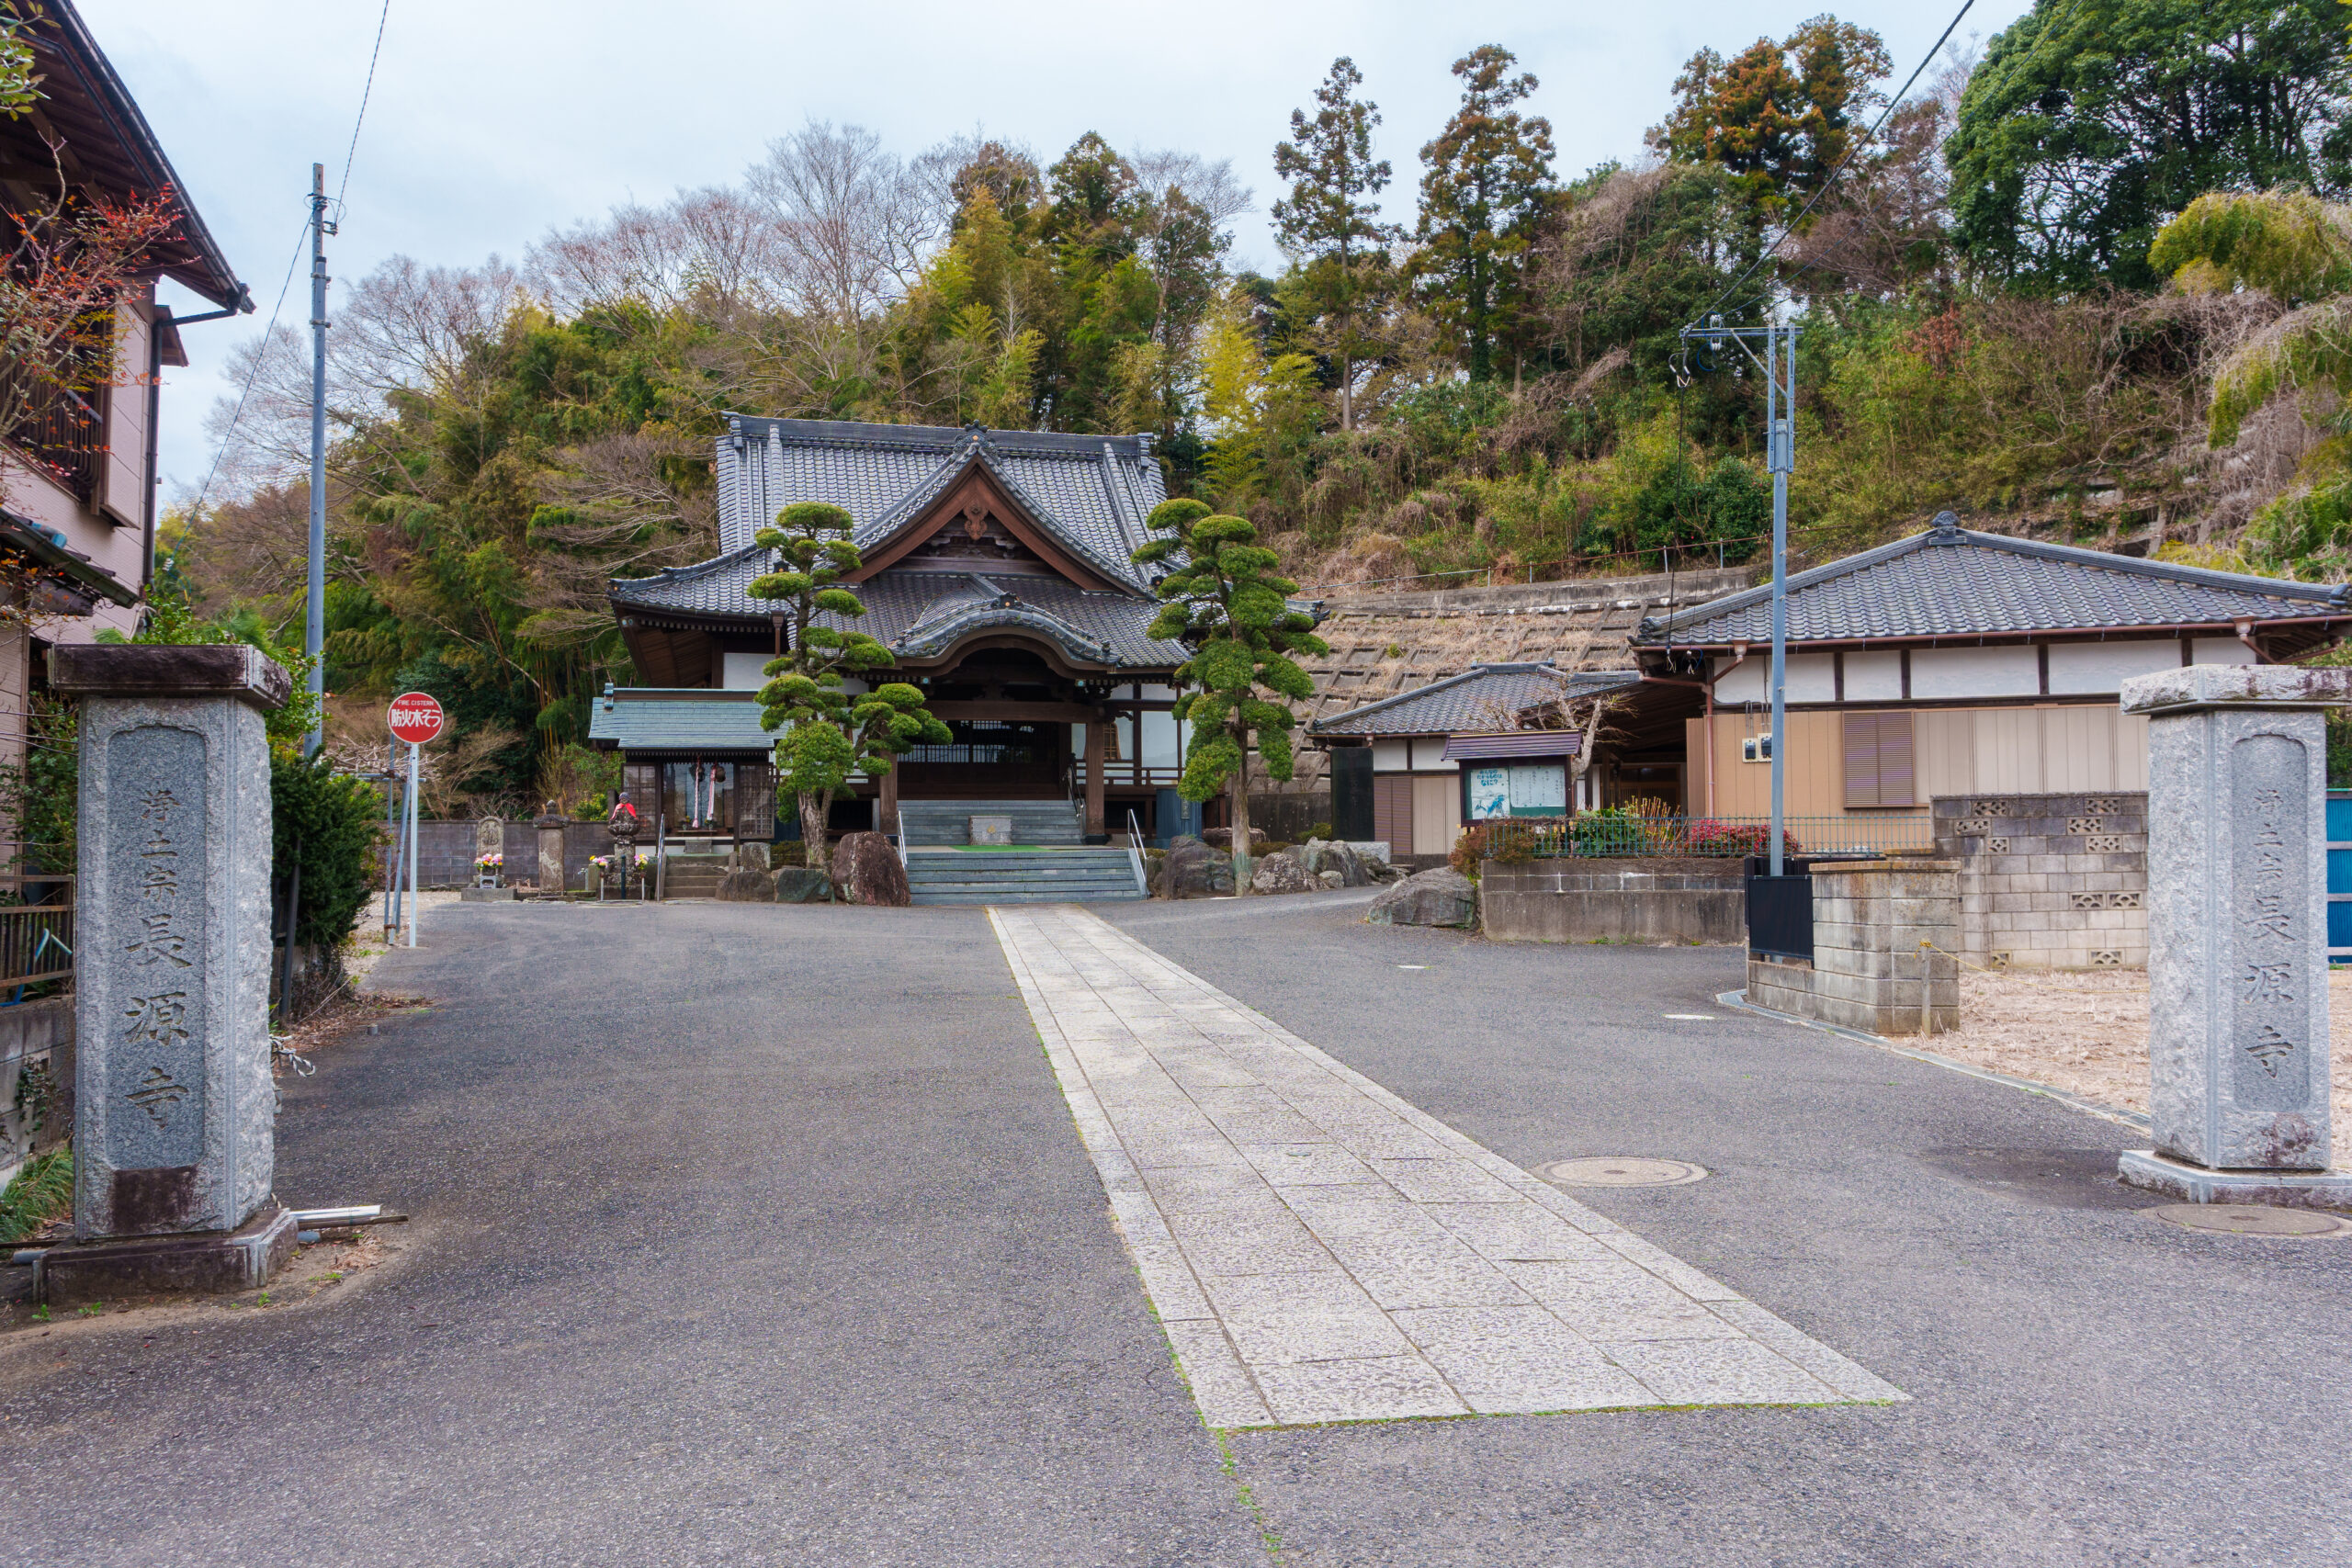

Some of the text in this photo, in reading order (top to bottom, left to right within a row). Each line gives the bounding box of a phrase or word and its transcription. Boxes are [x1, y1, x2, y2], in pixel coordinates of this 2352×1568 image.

[391, 708, 441, 728] 防火水そう
